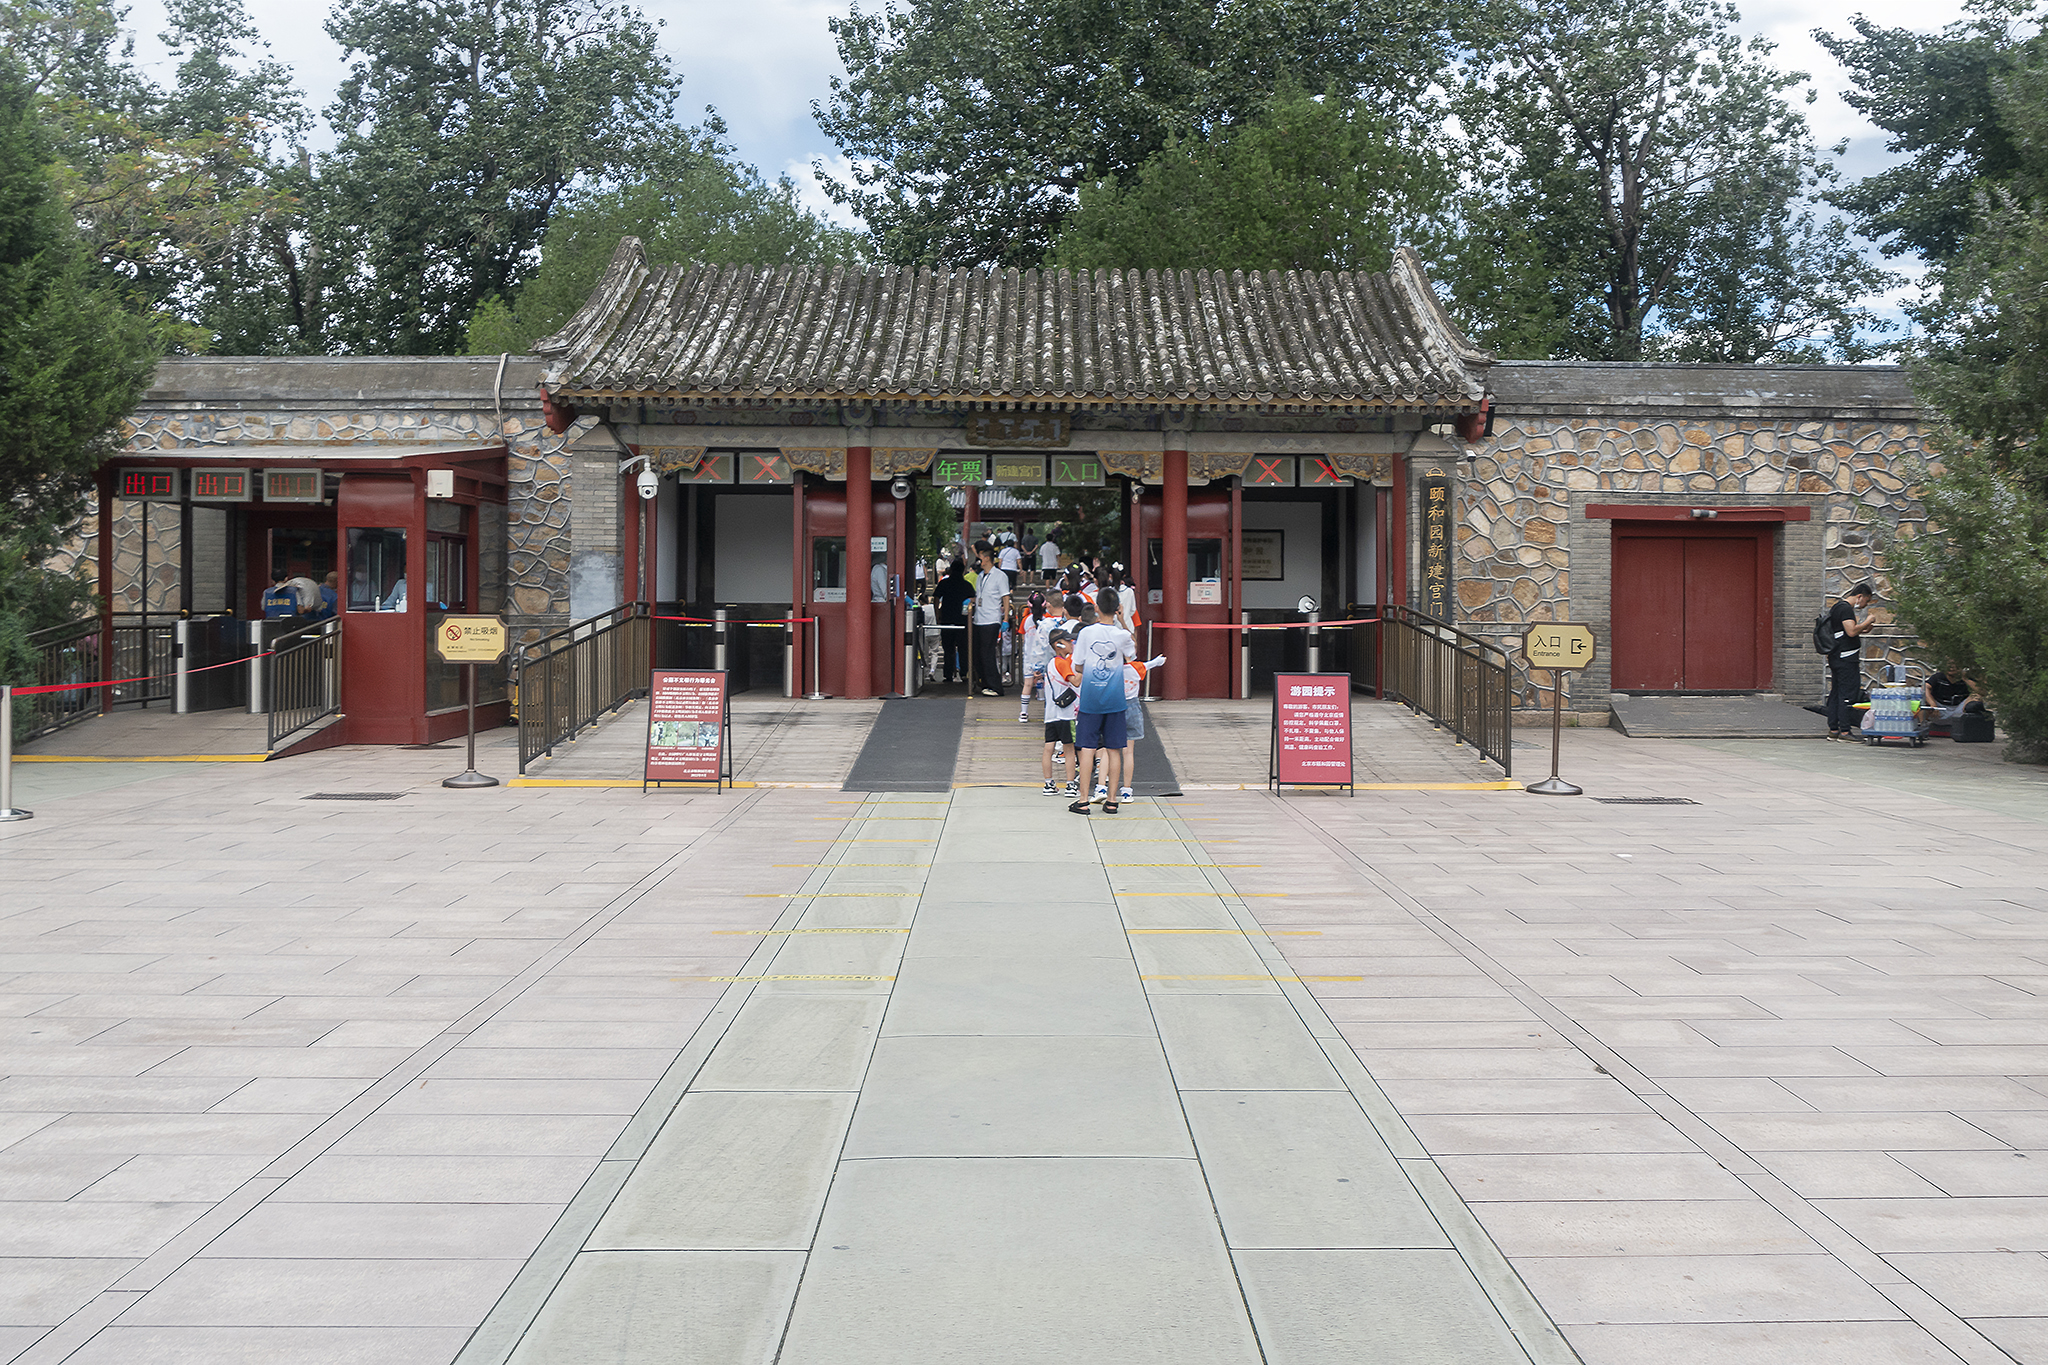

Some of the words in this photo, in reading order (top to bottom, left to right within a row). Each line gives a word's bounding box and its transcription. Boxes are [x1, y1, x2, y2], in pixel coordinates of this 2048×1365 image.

[937, 460, 982, 482] 年票
[996, 465, 1042, 478] 新建宫门
[1057, 461, 1098, 481] 入口
[126, 473, 170, 494] 出口
[198, 473, 242, 495] 出口
[271, 474, 314, 496] 出口
[1428, 486, 1445, 616] 颐和园新建宫门
[464, 627, 498, 635] 禁止吸烟
[1534, 635, 1560, 648] 入口
[1290, 685, 1336, 697] 游园提示
